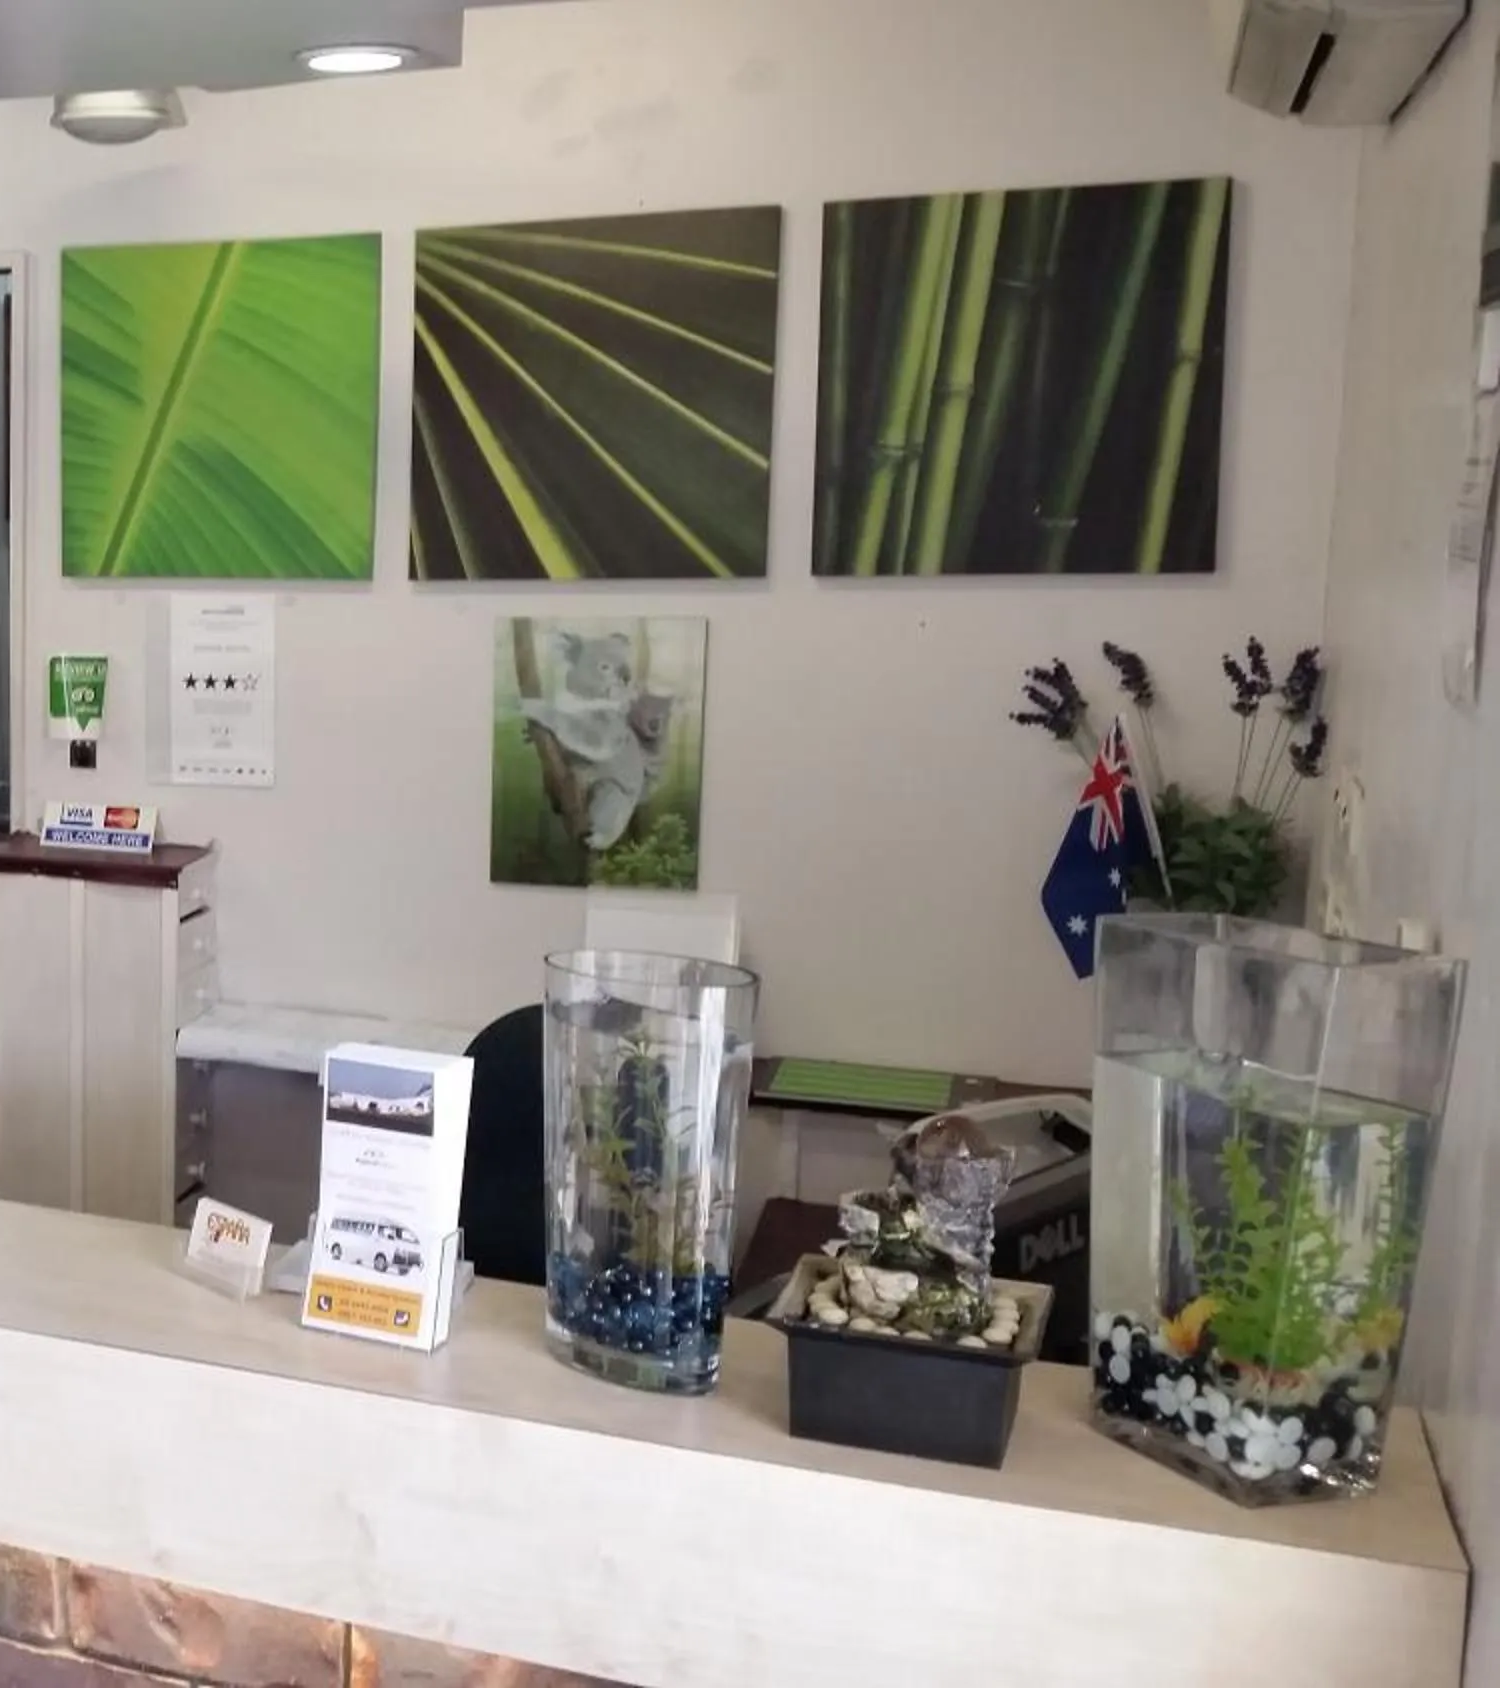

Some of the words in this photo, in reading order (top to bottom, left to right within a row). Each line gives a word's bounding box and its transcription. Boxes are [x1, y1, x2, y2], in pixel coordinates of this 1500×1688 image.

[67, 806, 93, 818] VISA
[51, 829, 109, 845] WELCOME
[109, 833, 144, 848] HERE
[1019, 1212, 1085, 1274] DELL
